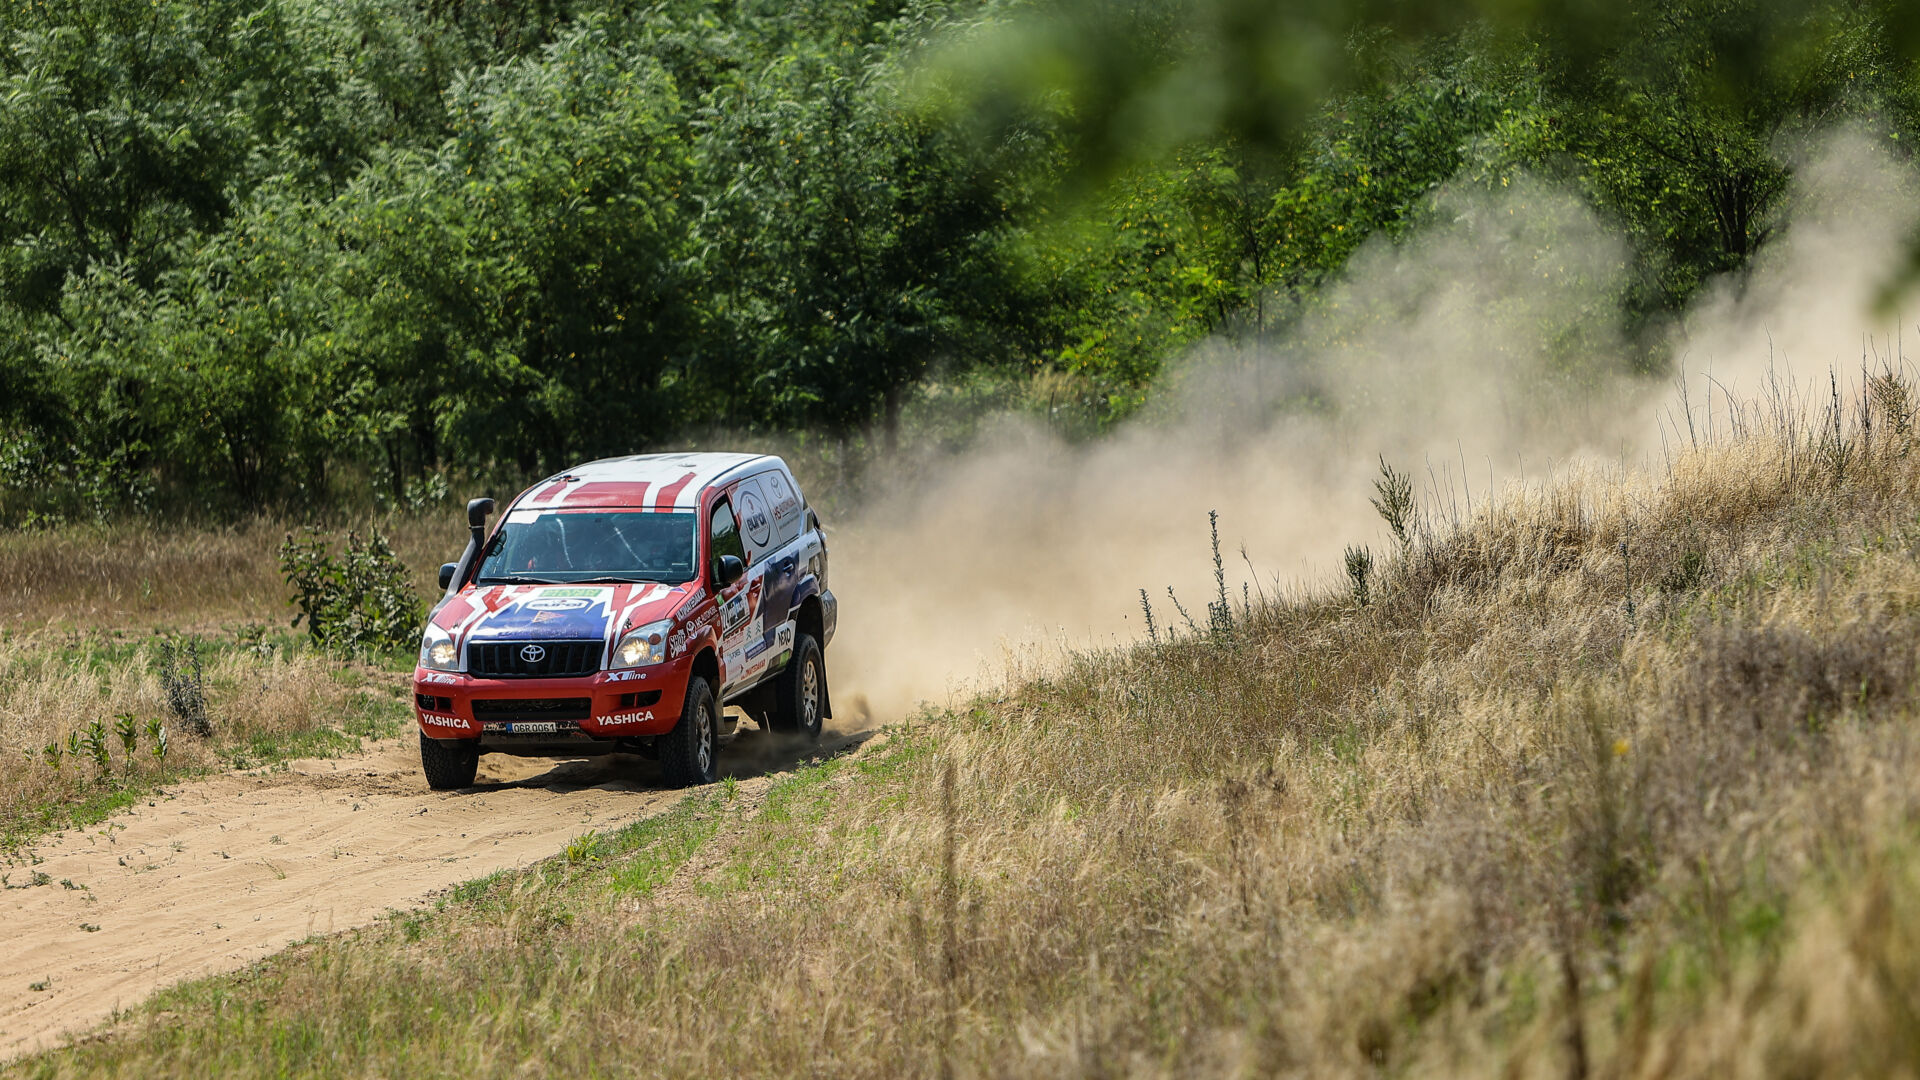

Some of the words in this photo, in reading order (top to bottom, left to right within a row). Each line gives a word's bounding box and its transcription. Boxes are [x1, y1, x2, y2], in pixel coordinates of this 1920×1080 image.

[746, 512, 767, 532] eurol
[604, 670, 647, 683] XTline
[422, 713, 471, 729] YASHICA
[596, 710, 655, 726] YASHICA
